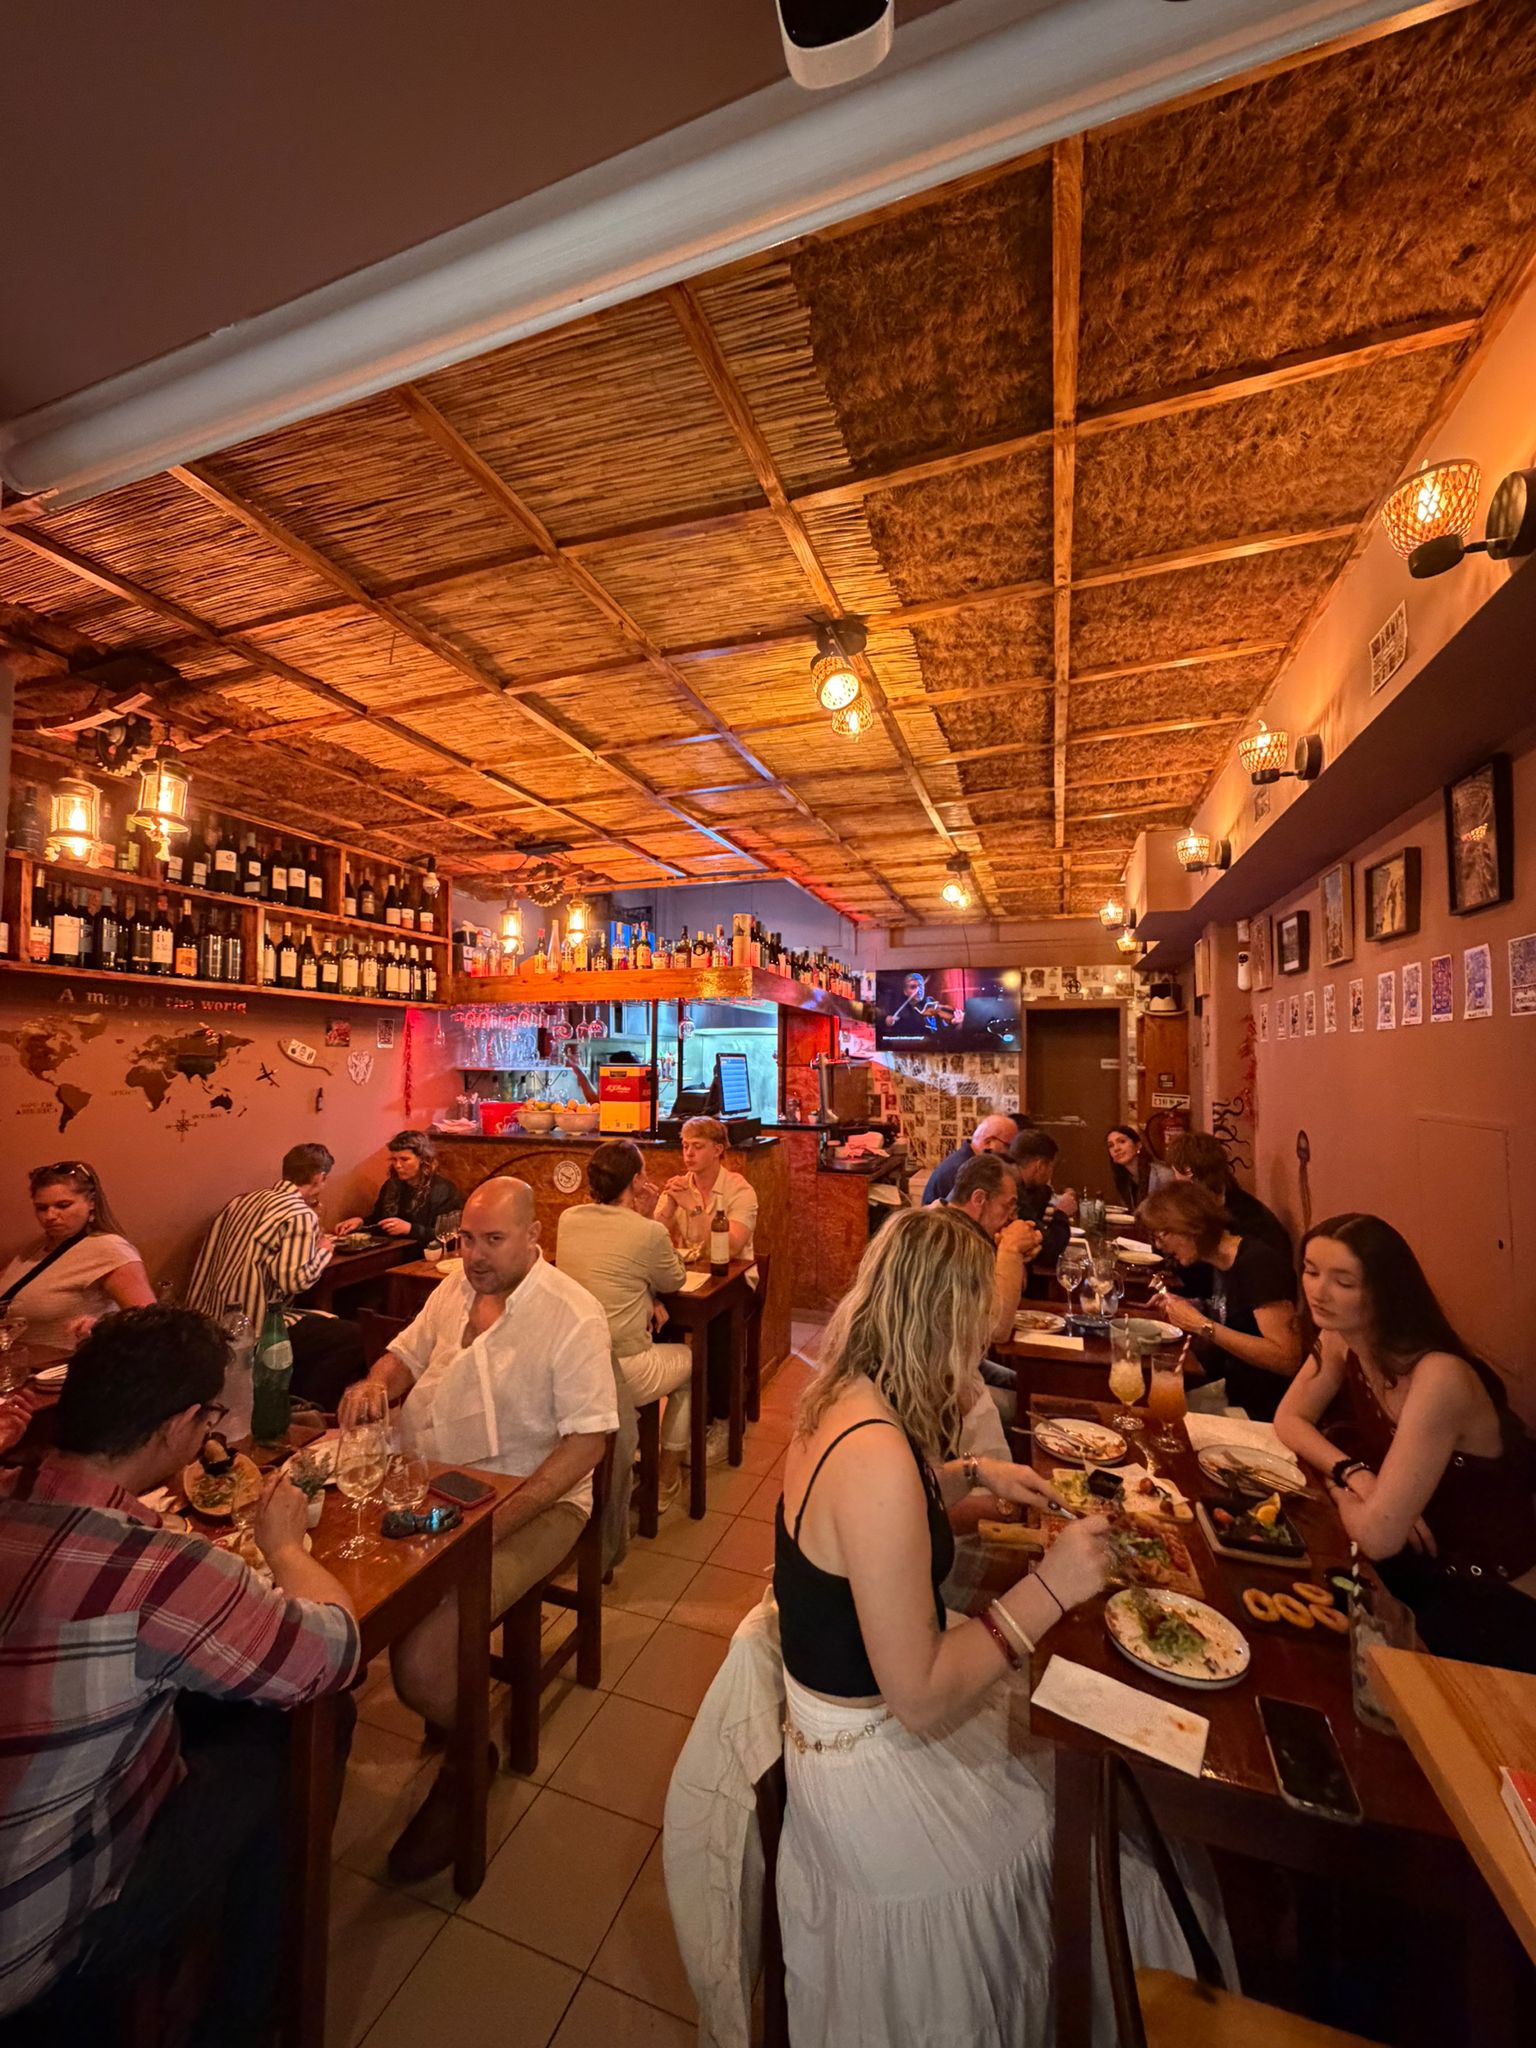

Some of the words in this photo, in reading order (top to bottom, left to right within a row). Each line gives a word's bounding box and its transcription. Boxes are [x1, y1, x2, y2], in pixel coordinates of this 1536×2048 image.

[60, 988, 74, 1002] A
[87, 991, 129, 1009] map
[165, 997, 195, 1010] the
